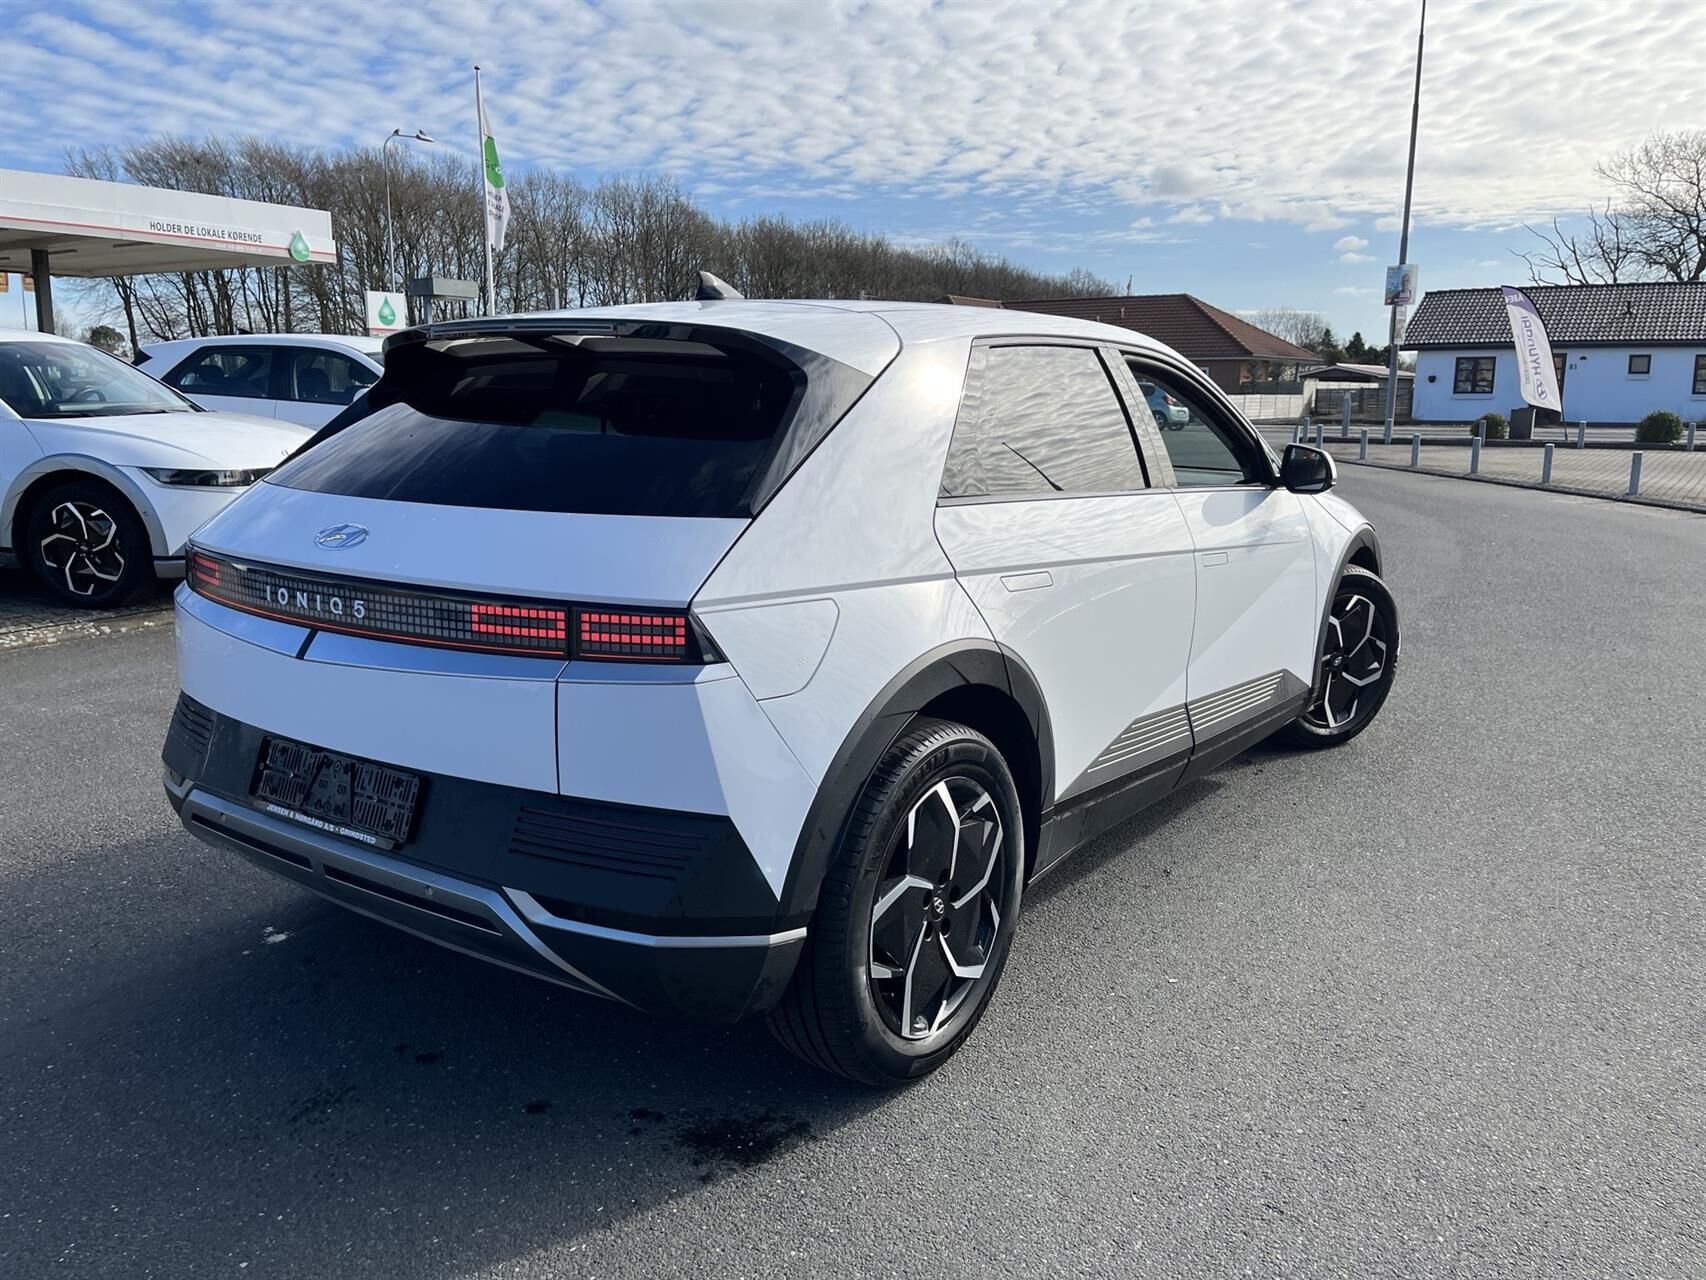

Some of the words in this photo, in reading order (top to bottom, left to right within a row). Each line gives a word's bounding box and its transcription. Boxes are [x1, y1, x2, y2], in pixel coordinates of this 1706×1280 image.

[150, 221, 182, 233] HOLDER
[184, 225, 195, 235] DE
[196, 227, 226, 239] LOKALE
[227, 230, 263, 243] KØRENDE
[266, 804, 288, 816] JENSEN
[339, 827, 377, 844] GRINDSTED
